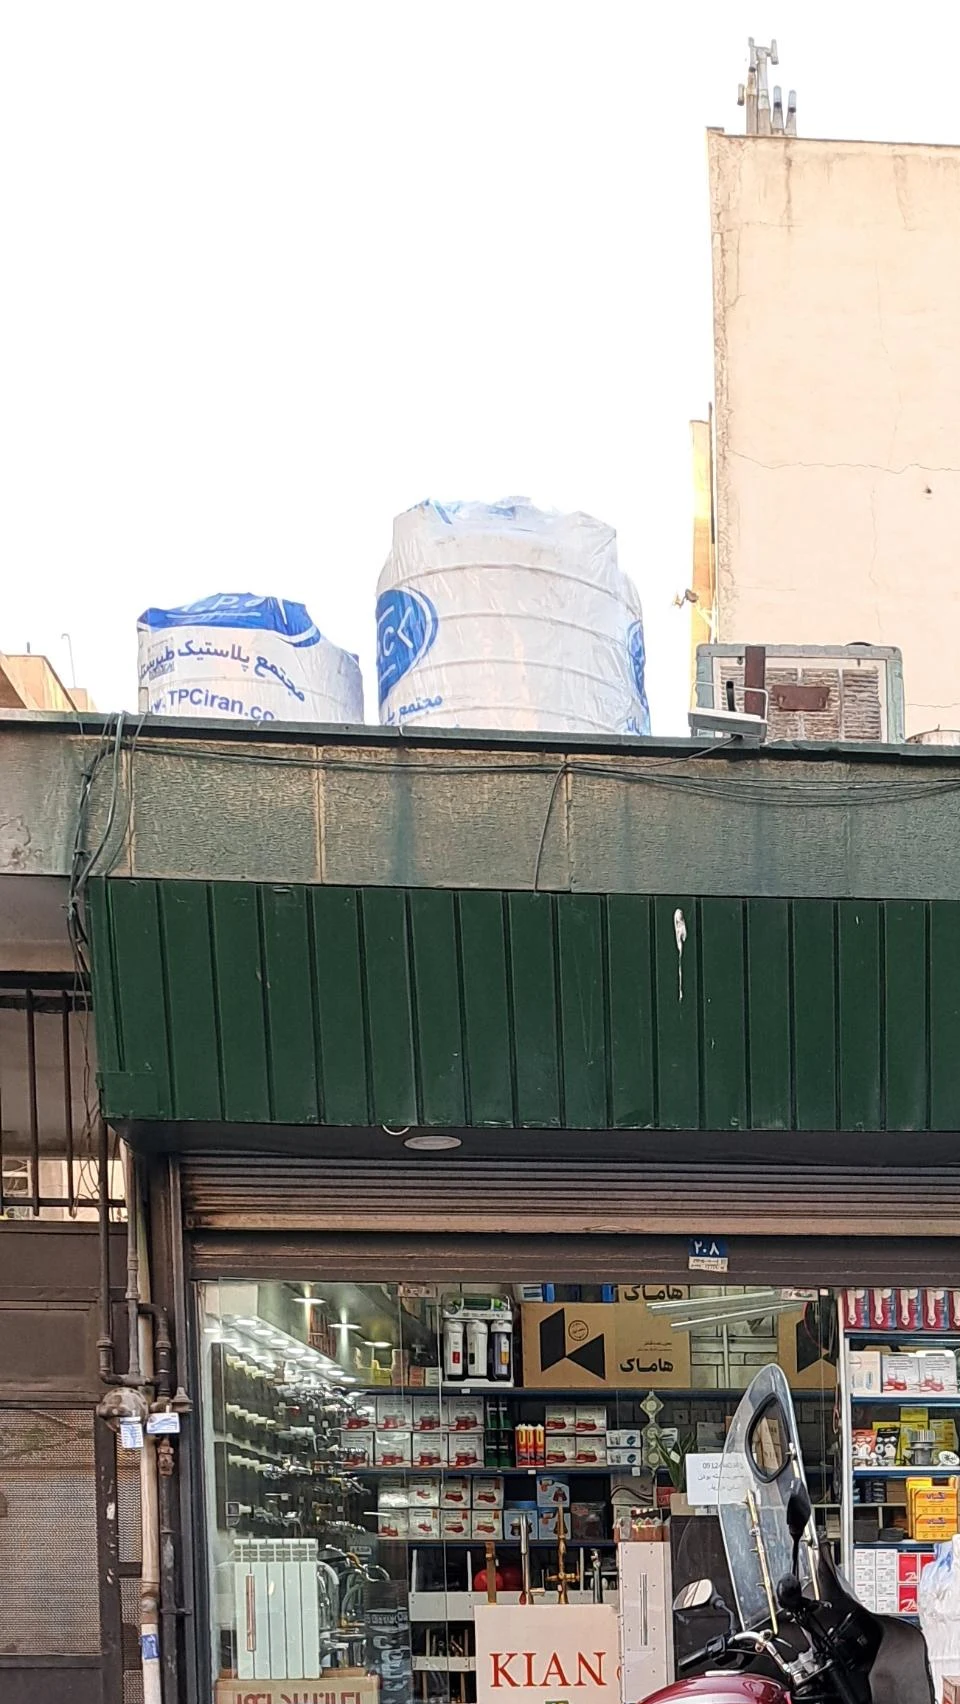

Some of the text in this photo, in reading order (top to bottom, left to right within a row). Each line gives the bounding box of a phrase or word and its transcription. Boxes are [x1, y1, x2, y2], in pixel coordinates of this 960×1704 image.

[178, 639, 250, 672] پلاستیک
[254, 655, 305, 701] مجتمع
[694, 1240, 720, 1256] ۲۰۸
[619, 1358, 674, 1373] هاماک
[489, 1651, 608, 1688] KIAN
